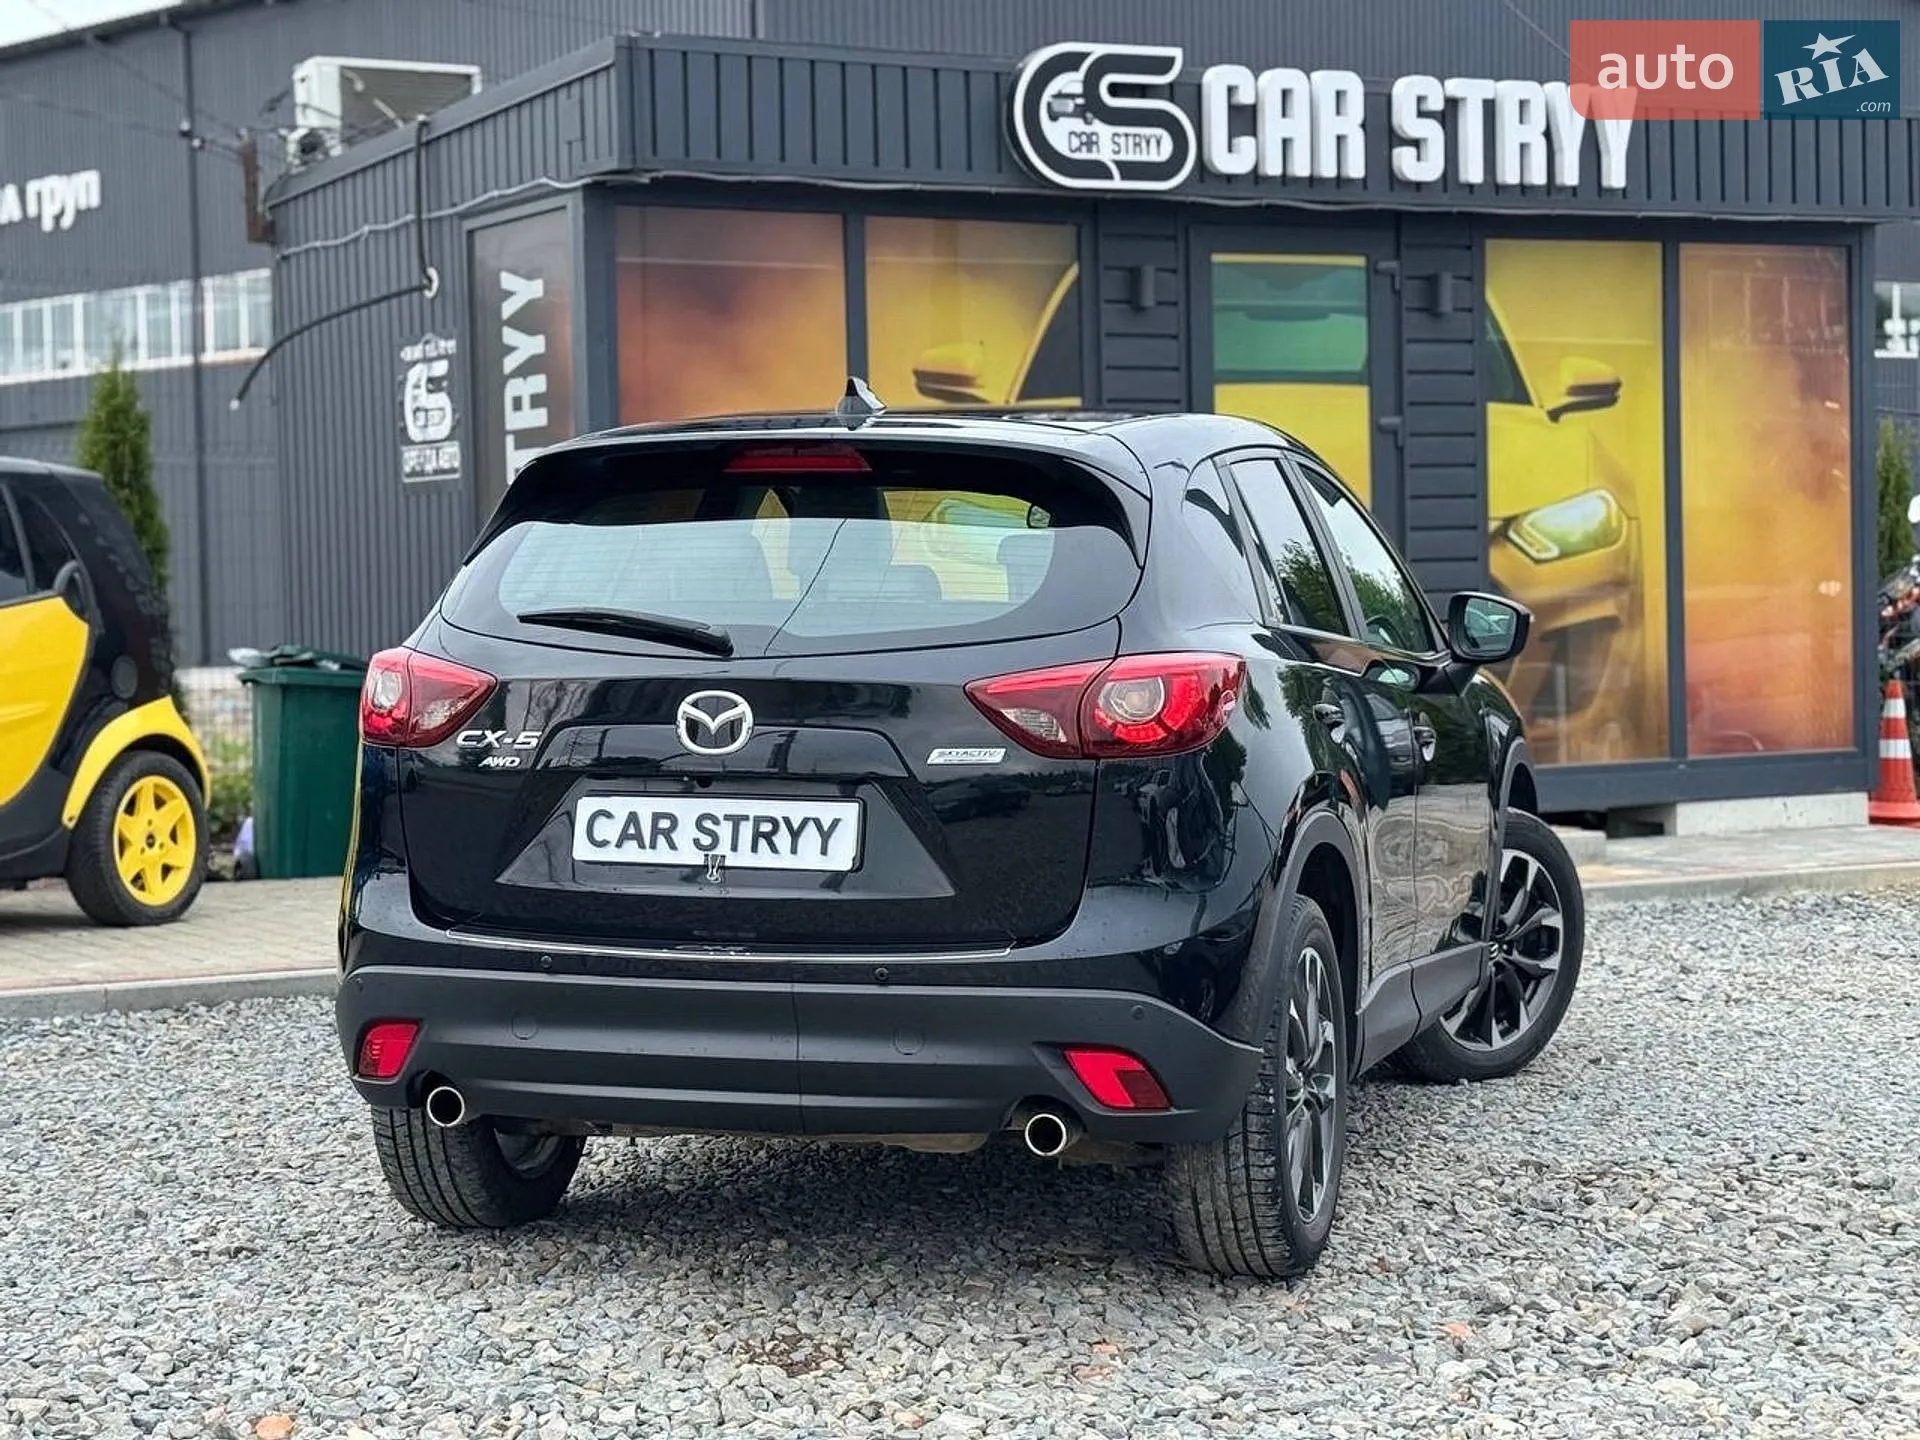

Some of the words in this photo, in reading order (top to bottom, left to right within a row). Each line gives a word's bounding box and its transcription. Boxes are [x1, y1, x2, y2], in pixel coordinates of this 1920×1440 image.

[1068, 131, 1100, 154] CAR
[1111, 132, 1163, 157] STRYY
[1202, 64, 1366, 179] CAR
[1391, 74, 1639, 189] STRYY
[26, 169, 101, 232] груп
[456, 730, 542, 749] CX-5
[478, 756, 521, 768] AWD
[586, 808, 679, 851] CAR
[693, 812, 842, 857] STRYY
